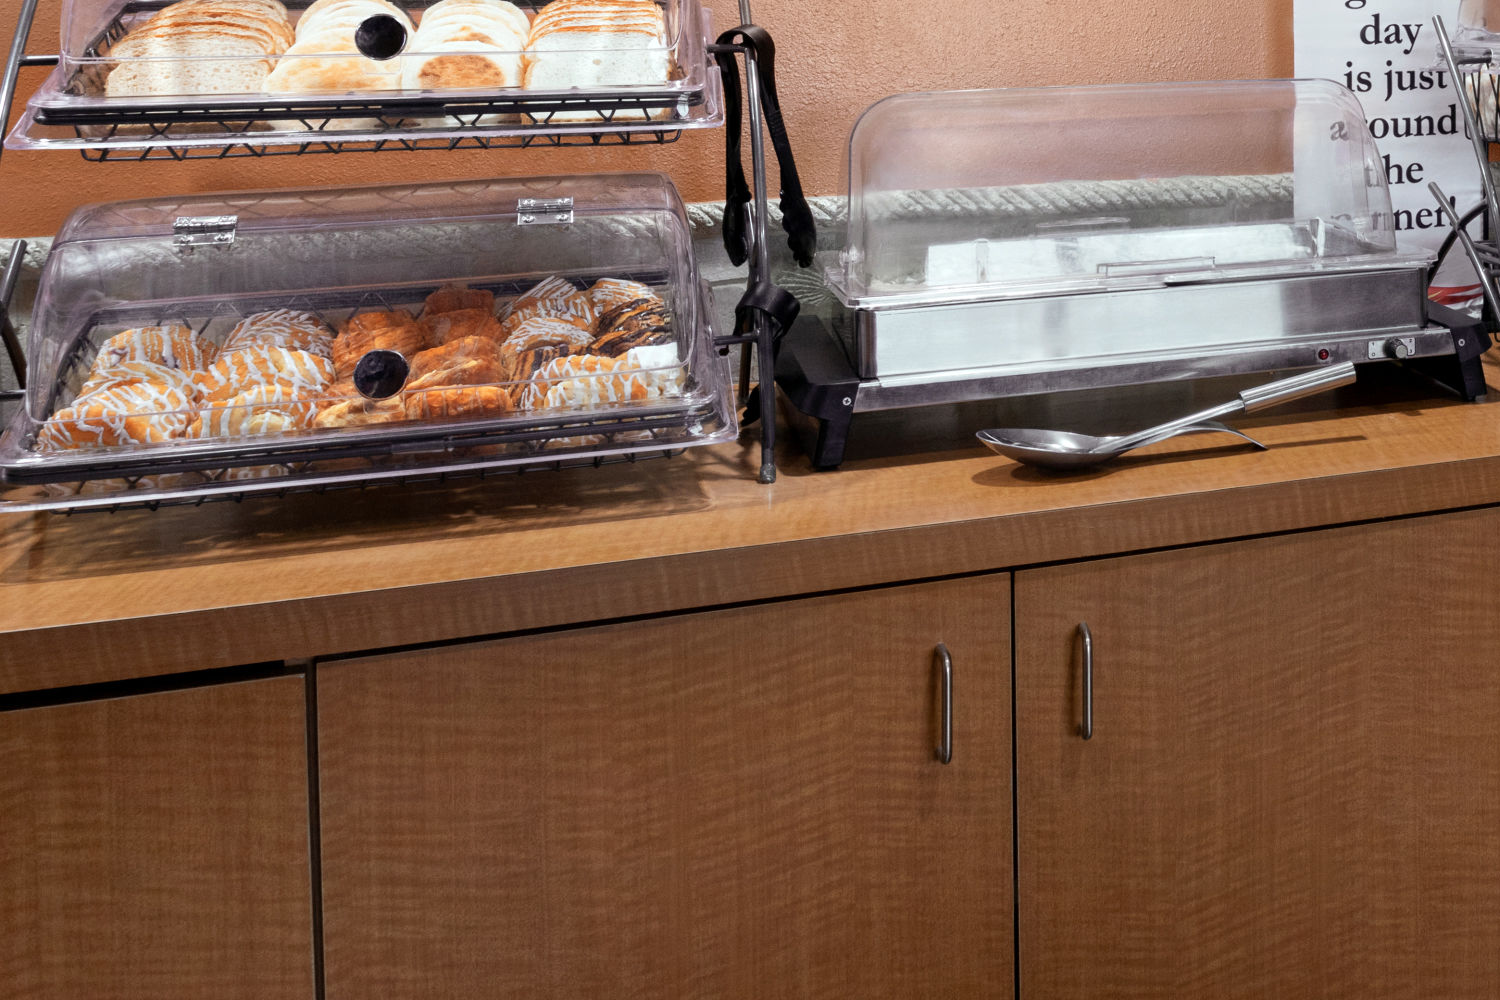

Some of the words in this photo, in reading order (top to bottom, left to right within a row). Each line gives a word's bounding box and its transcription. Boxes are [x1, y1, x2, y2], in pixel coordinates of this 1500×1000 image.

[1360, 13, 1423, 54] day
[1344, 61, 1372, 93] is
[1383, 60, 1448, 101] just
[1330, 104, 1458, 142] aound
